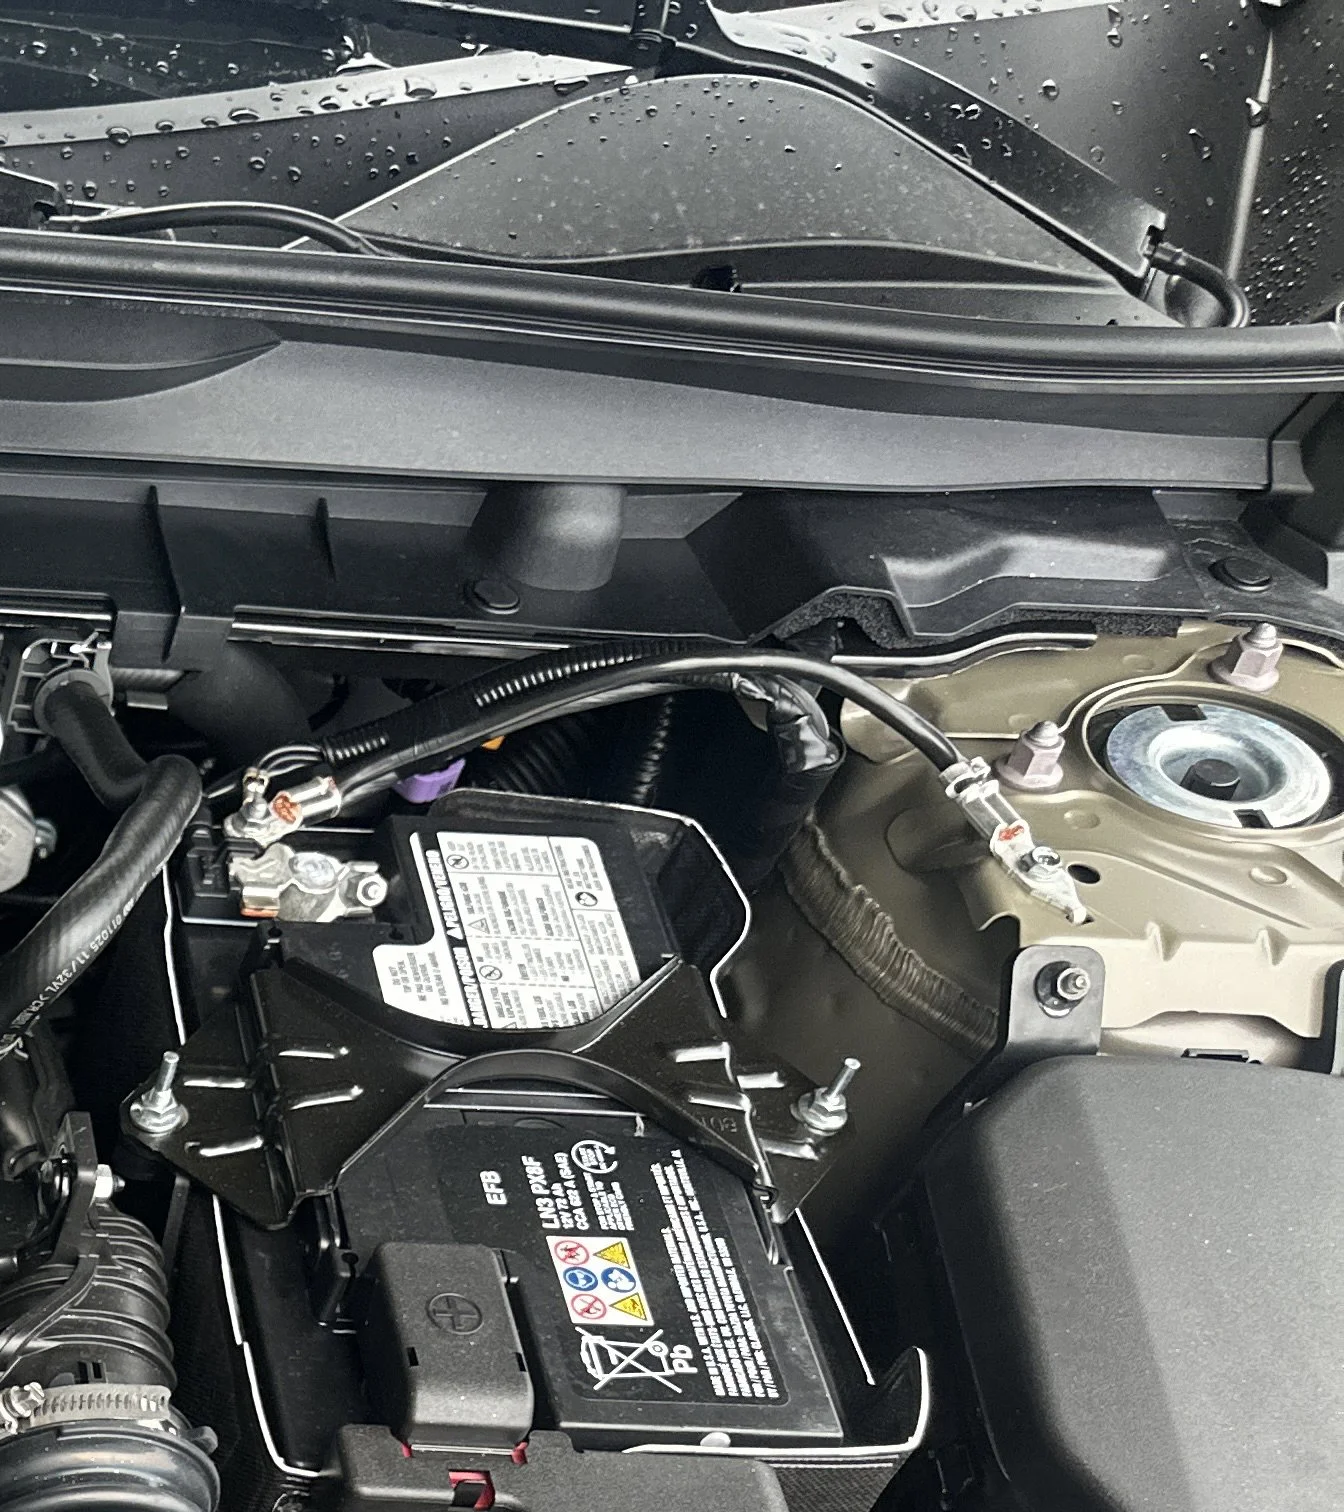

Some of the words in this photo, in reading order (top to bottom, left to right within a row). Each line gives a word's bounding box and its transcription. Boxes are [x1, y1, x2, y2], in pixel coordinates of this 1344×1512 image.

[479, 1170, 508, 1205] EFB
[520, 1154, 548, 1196] PX8F
[535, 1197, 561, 1230] LN3
[670, 1344, 698, 1374] Pb
